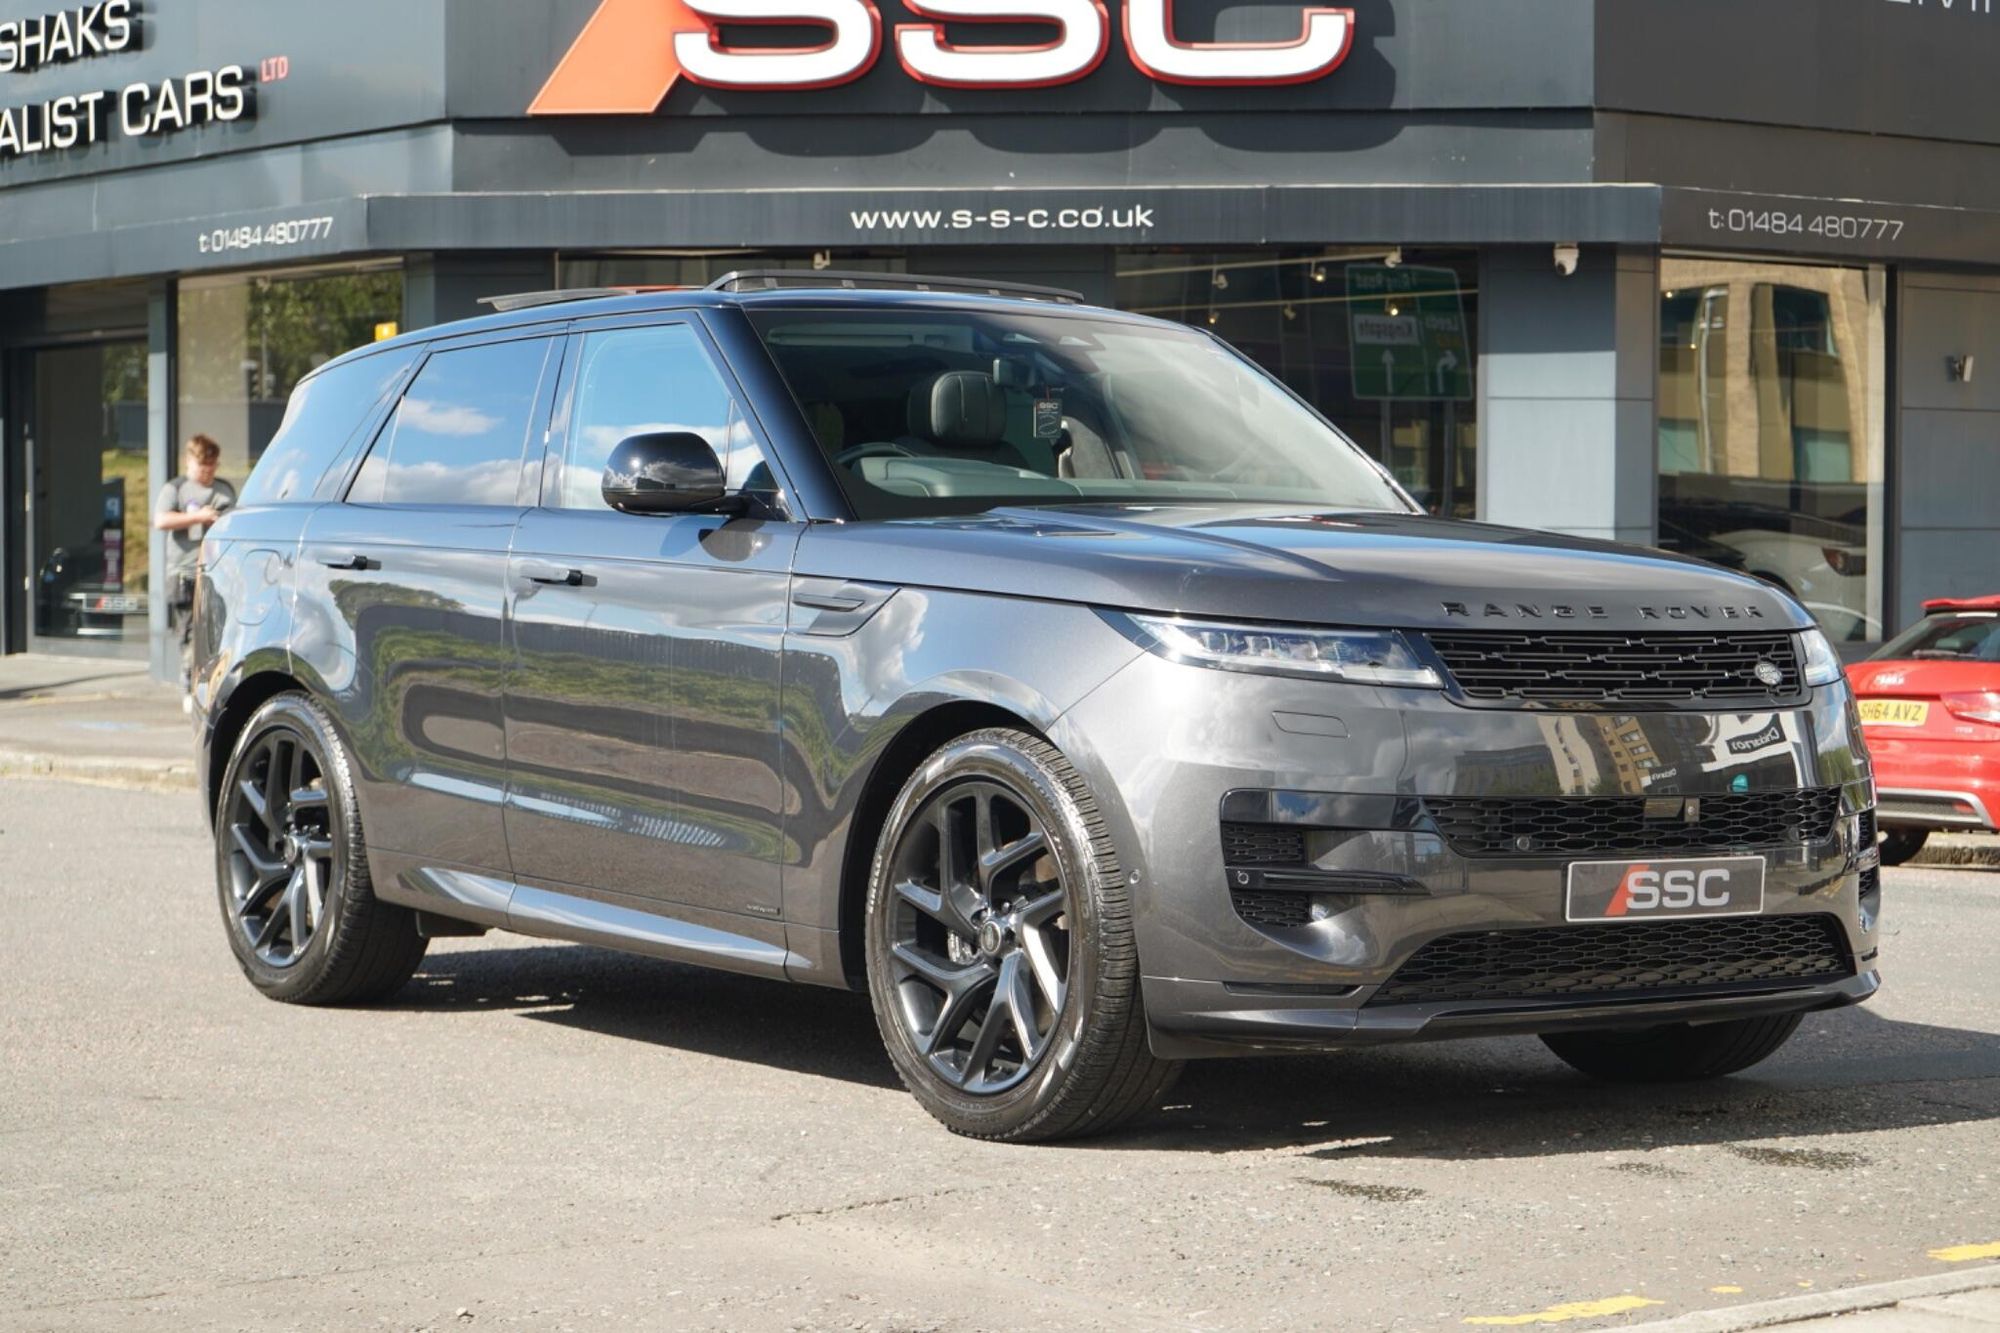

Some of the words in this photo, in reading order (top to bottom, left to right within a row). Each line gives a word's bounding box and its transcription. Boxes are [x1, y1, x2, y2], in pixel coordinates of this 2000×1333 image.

[121, 65, 243, 136] CARS
[260, 56, 288, 82] LTD
[264, 216, 333, 245] 480777
[850, 204, 1154, 229] www.s-s-c.co.uk
[1808, 211, 1904, 240] 480777
[1440, 602, 1608, 619] RANGE
[1637, 605, 1763, 619] ROVER
[1892, 704, 1923, 721] AVZ
[1626, 868, 1730, 909] SSC
